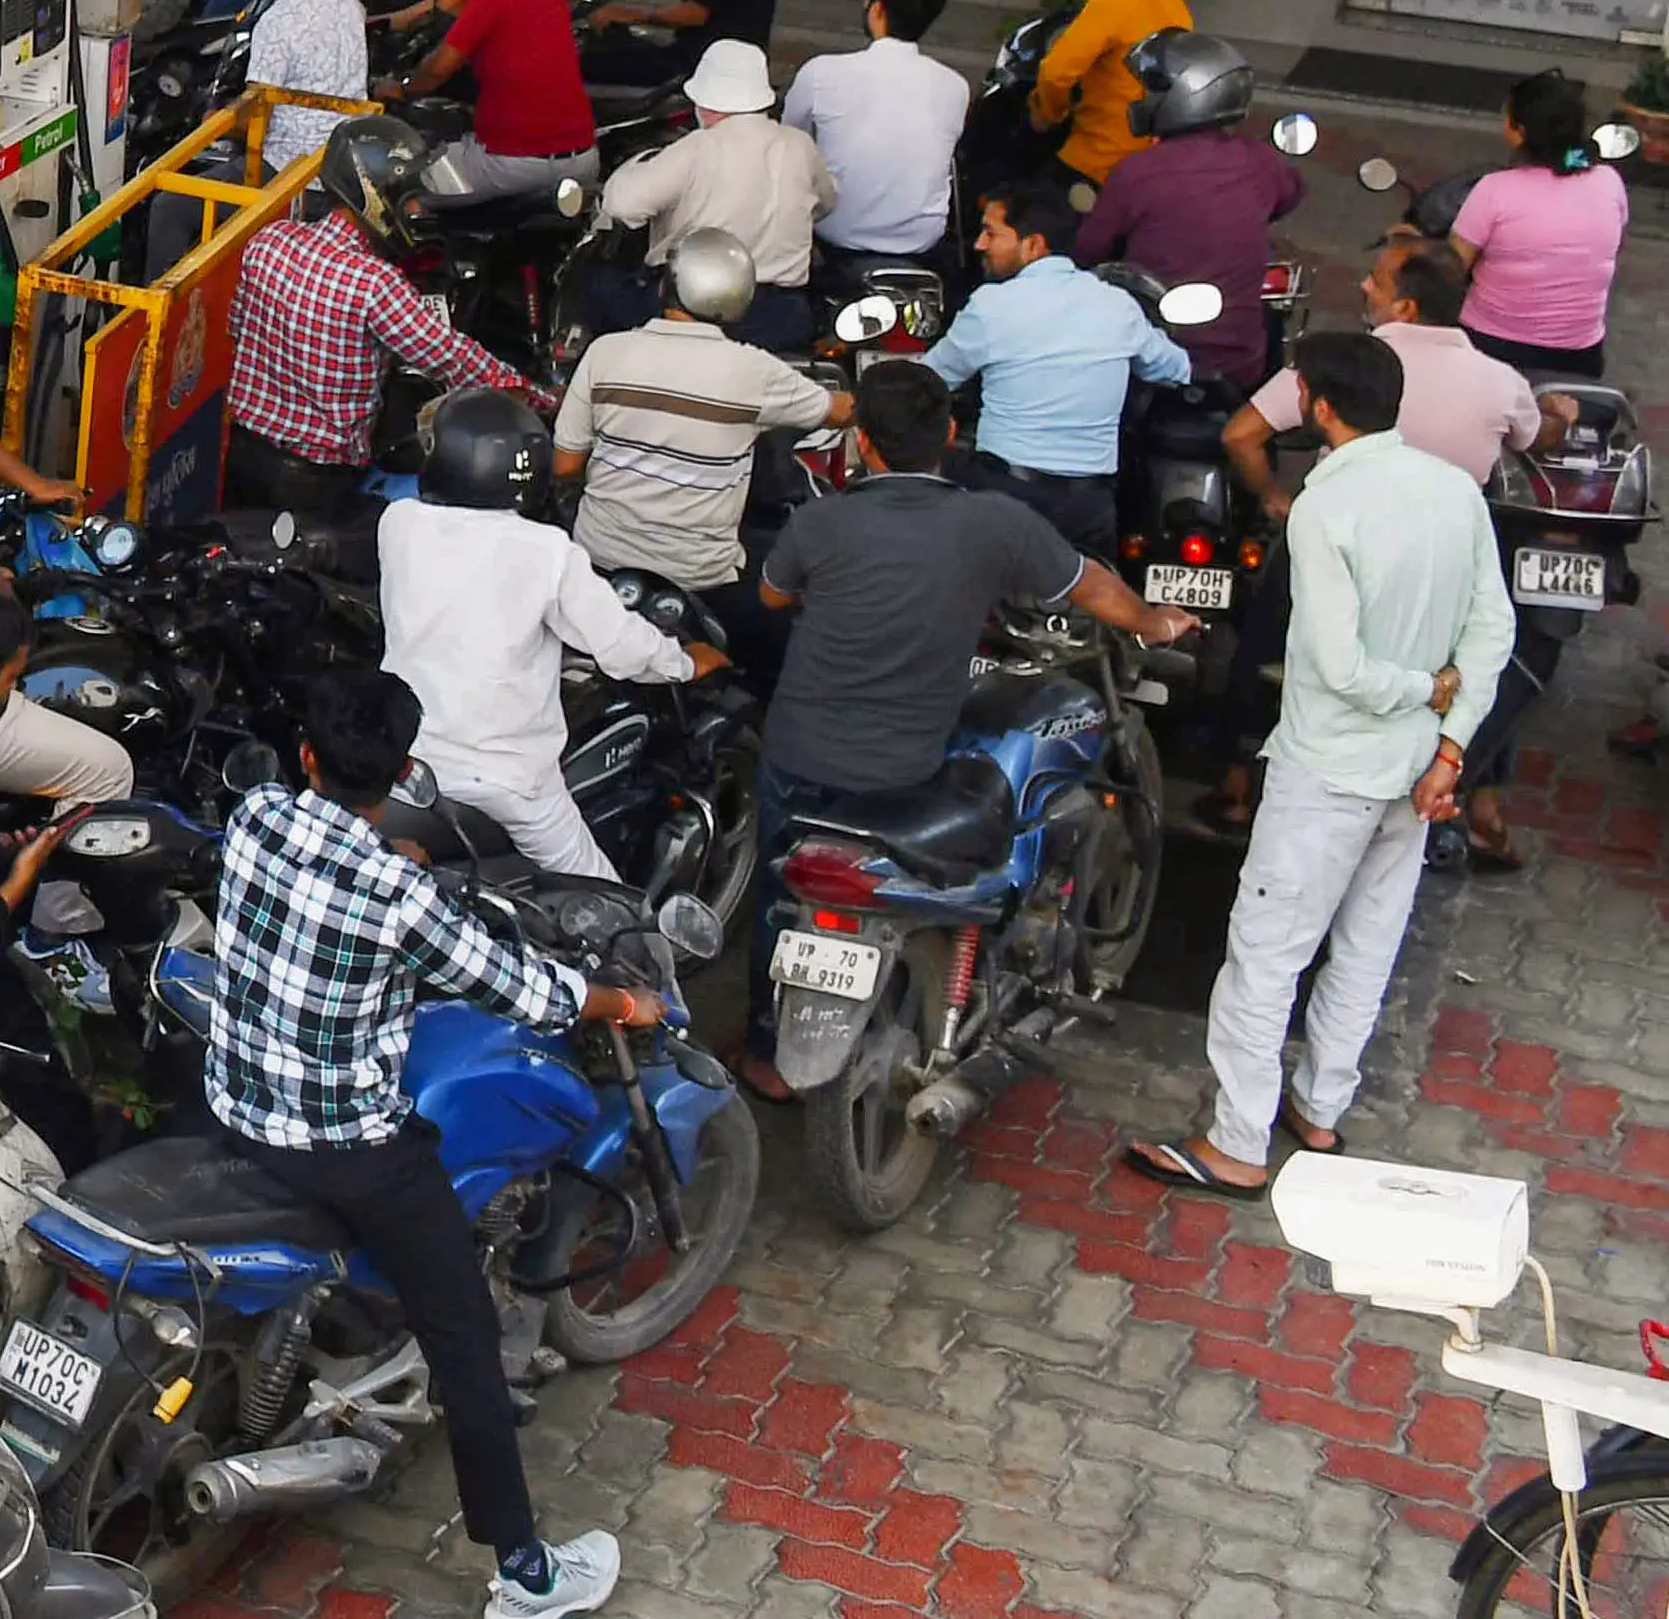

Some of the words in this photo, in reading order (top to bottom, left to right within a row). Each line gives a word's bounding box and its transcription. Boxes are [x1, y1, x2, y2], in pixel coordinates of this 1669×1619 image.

[34, 123, 65, 153] Petrol
[1163, 568, 1224, 588] UP70H
[1162, 586, 1223, 607] C4809
[797, 941, 816, 959] UP
[840, 949, 858, 967] 70
[817, 967, 855, 991] 9319
[21, 1328, 91, 1387] UP70C
